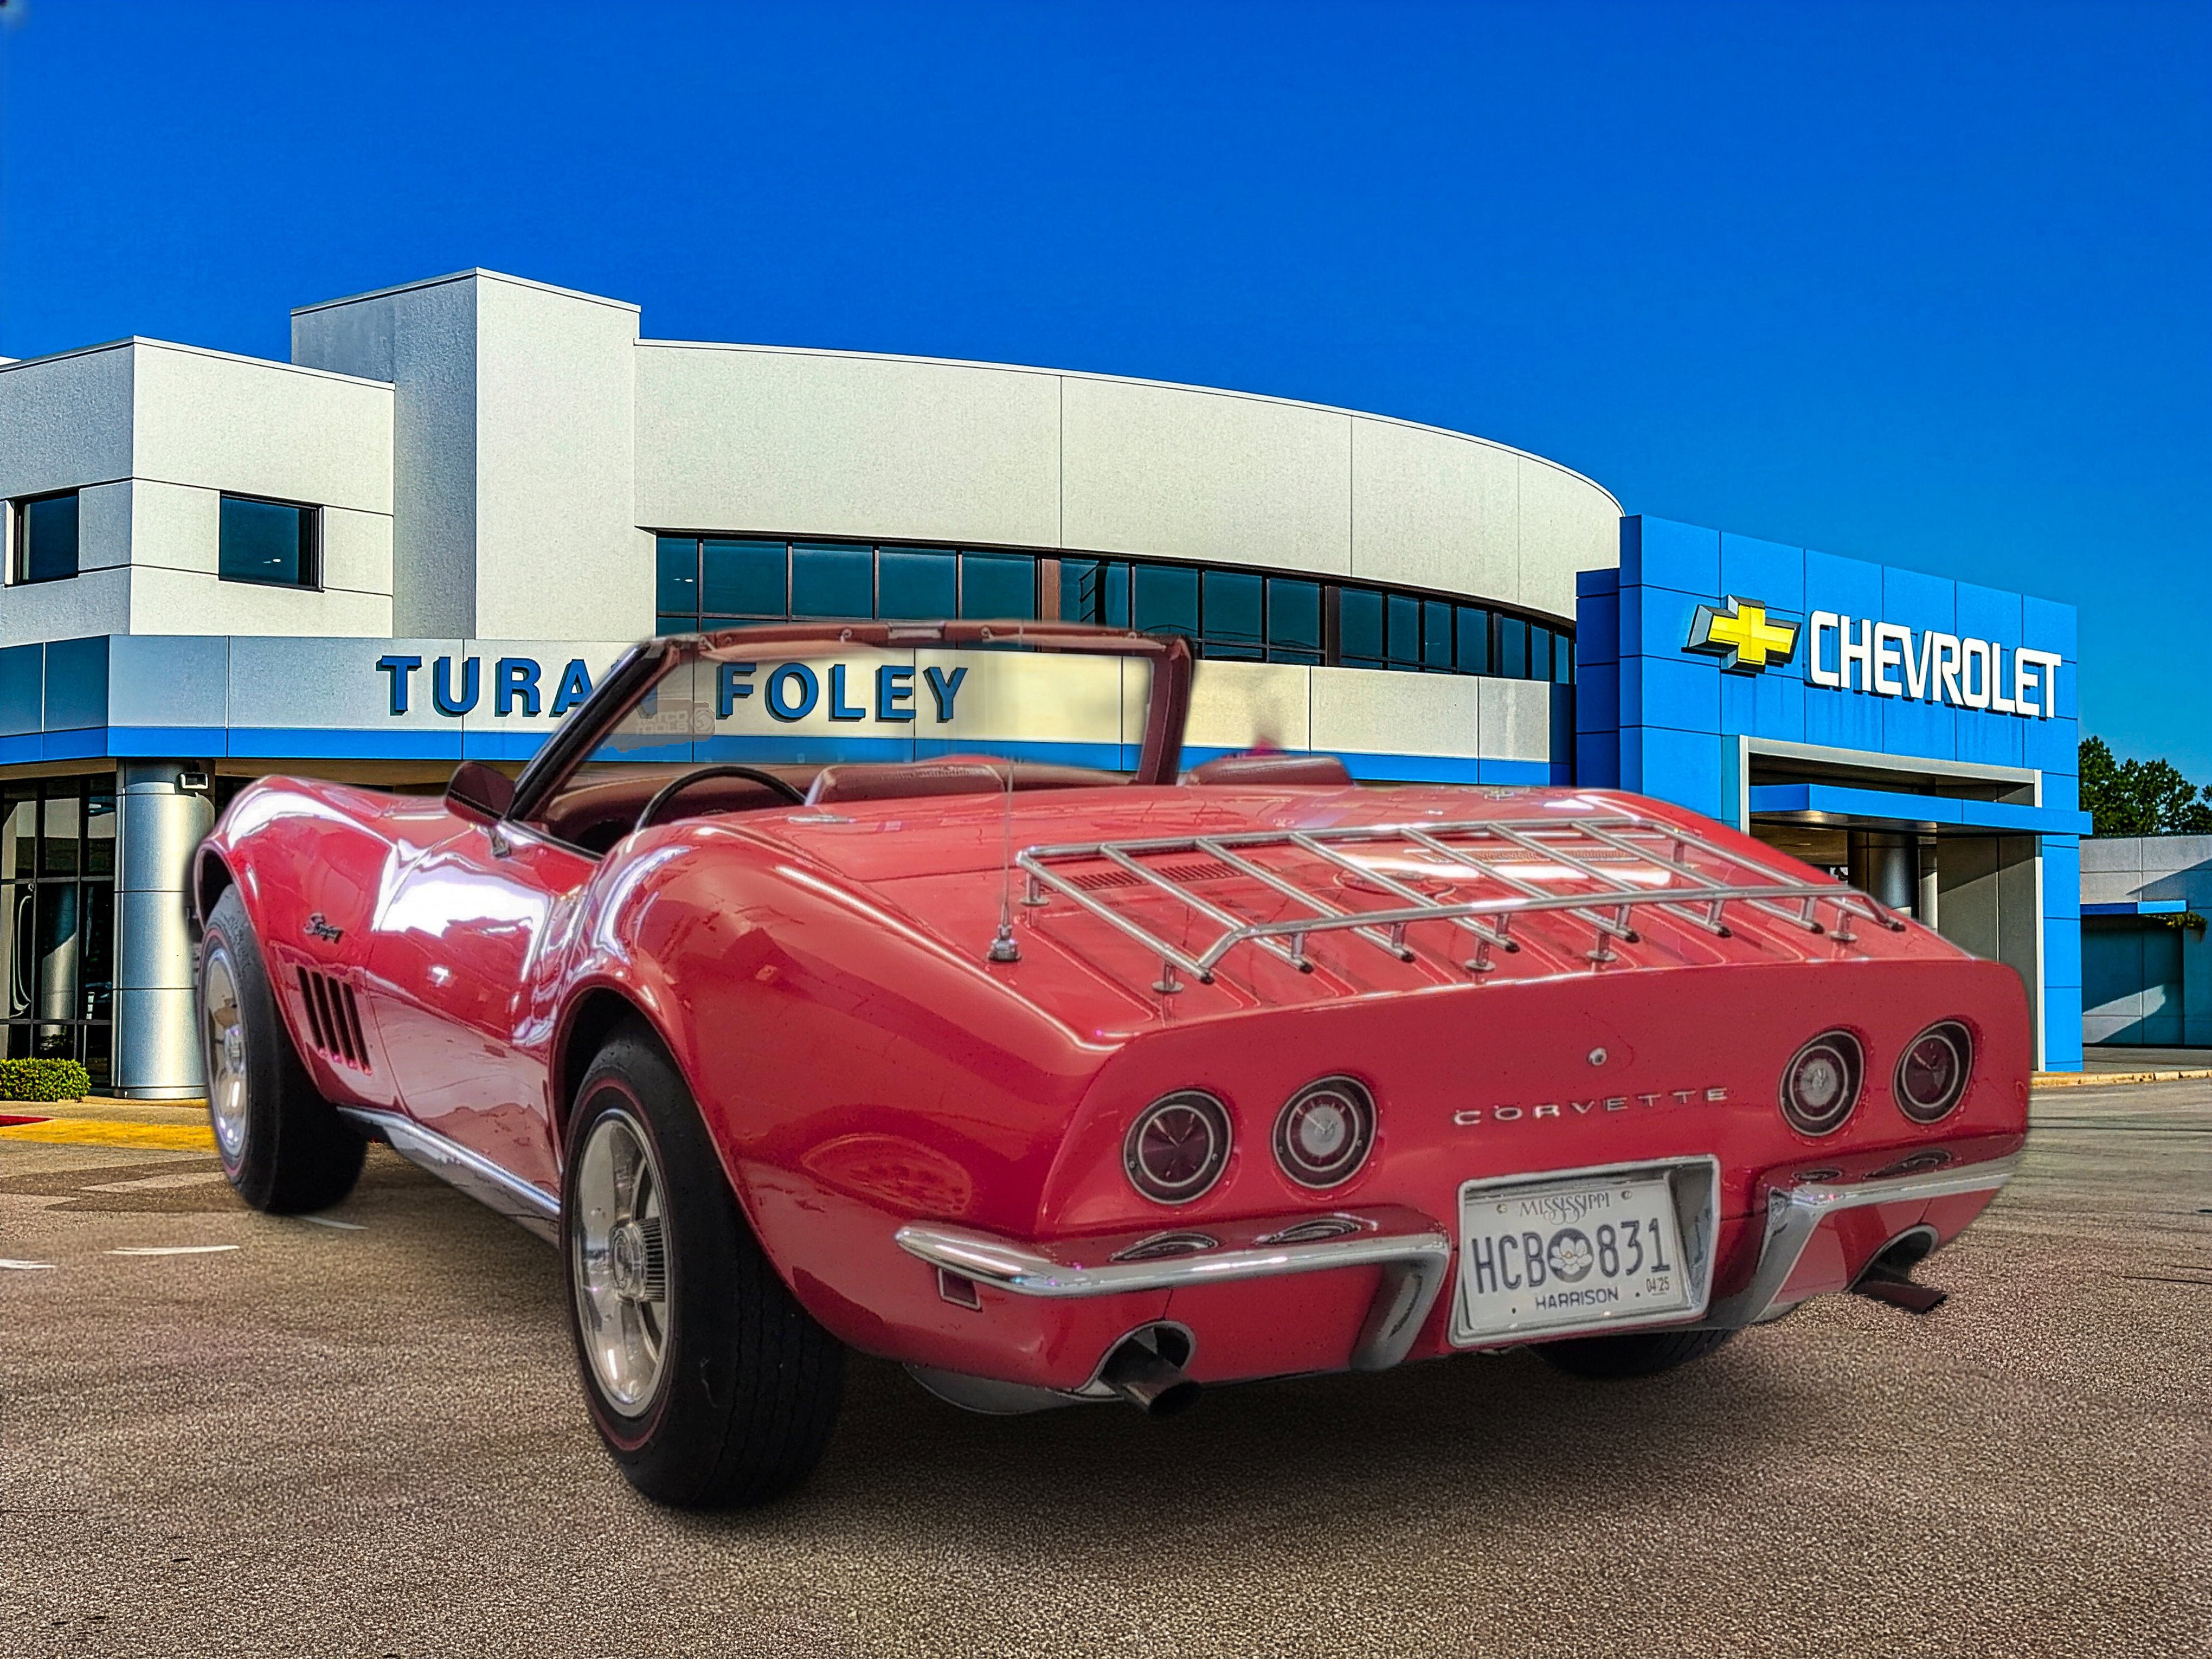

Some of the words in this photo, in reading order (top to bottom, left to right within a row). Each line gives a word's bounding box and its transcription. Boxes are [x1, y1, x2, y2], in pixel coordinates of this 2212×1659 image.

[1809, 610, 2061, 719] CHEVROLET
[716, 661, 968, 723] FOLEY
[1453, 1087, 1728, 1126] CORVETTE
[1519, 1192, 1610, 1225] MISSISSIPPI
[1471, 1231, 1546, 1294] HCB
[1597, 1217, 1670, 1278] 831
[1535, 1287, 1619, 1310] HARRISON
